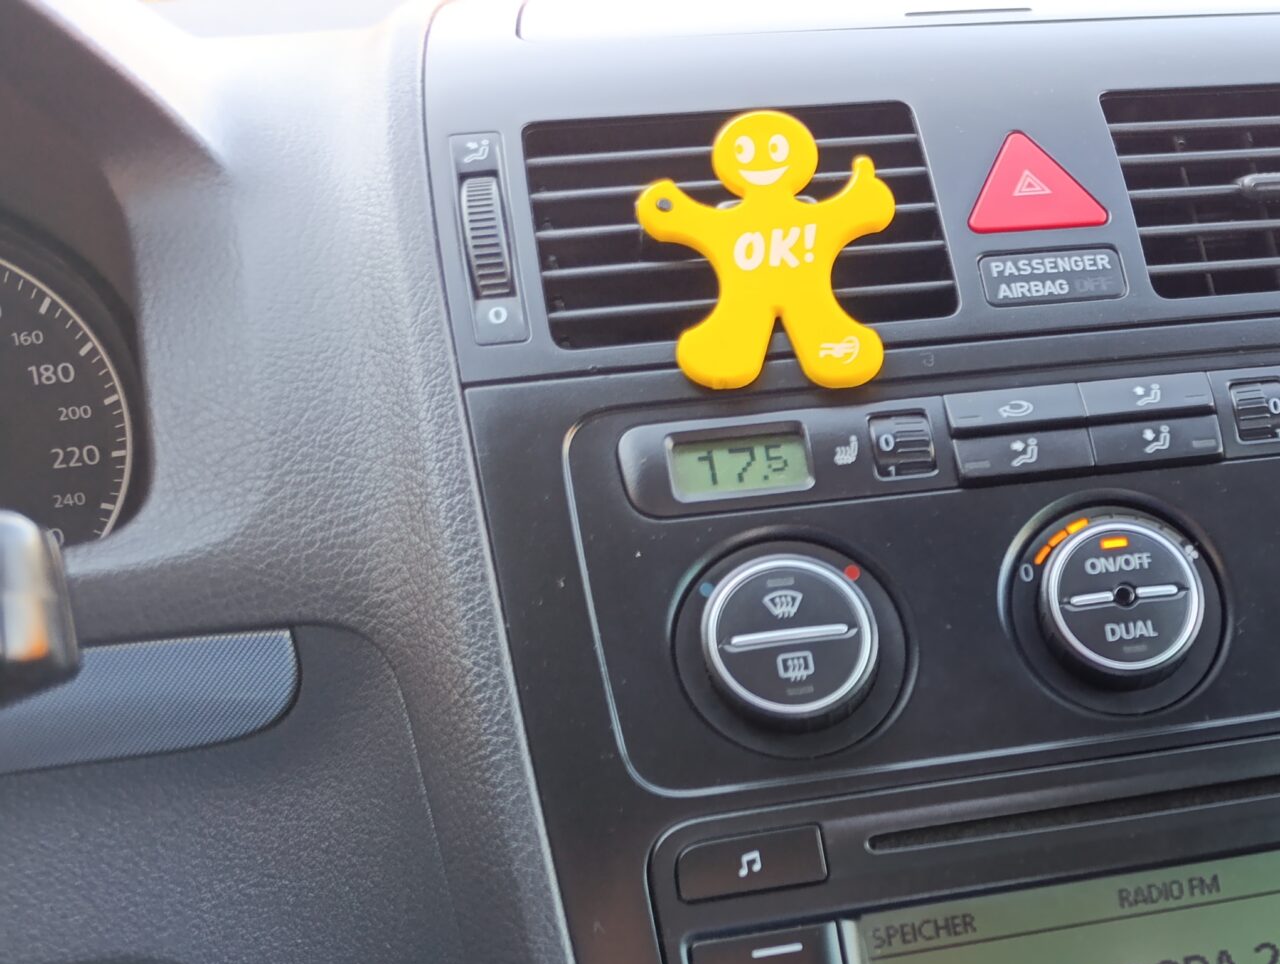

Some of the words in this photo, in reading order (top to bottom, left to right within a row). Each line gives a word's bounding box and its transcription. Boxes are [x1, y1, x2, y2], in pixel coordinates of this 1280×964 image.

[733, 223, 818, 271] OK!
[989, 254, 1112, 278] PASSENGER
[996, 278, 1070, 300] AIRBAG
[10, 329, 44, 347] 160
[27, 361, 76, 386] 180
[57, 404, 92, 422] 200
[879, 433, 895, 452] 0
[50, 444, 101, 469] 220
[53, 491, 86, 509] 240
[1084, 551, 1152, 576] ON/OFF
[1104, 619, 1158, 643] DUAL
[1117, 879, 1185, 909] RADIO
[1187, 873, 1221, 897] FM
[871, 912, 977, 950] SPEICHER
